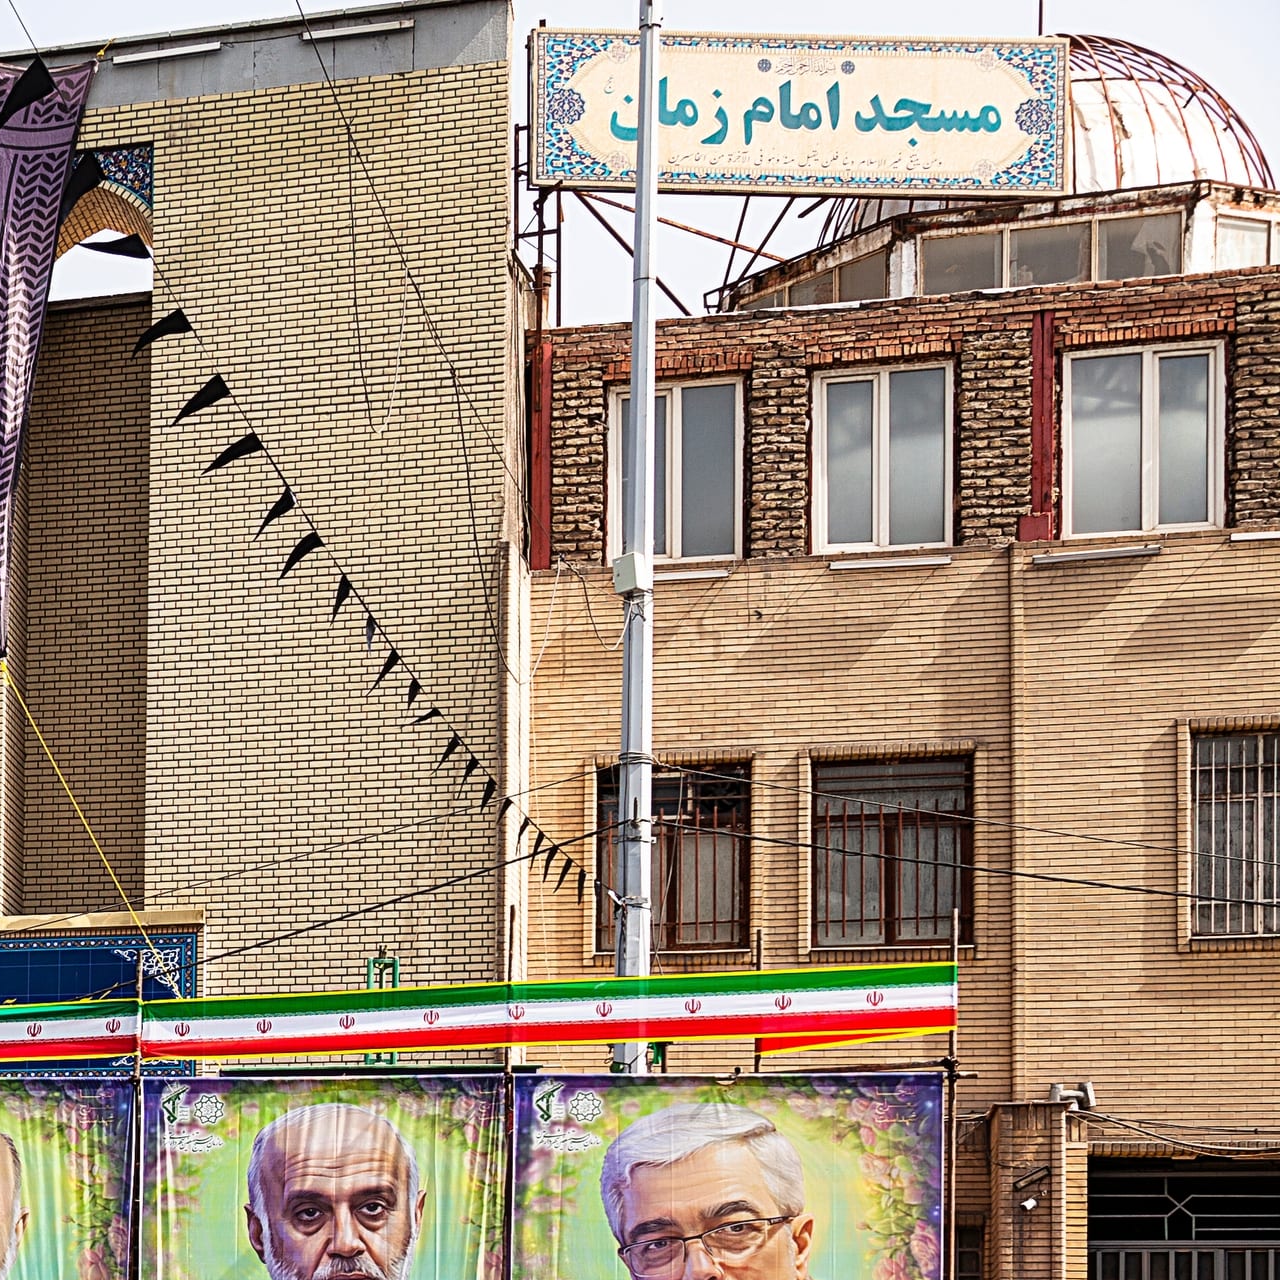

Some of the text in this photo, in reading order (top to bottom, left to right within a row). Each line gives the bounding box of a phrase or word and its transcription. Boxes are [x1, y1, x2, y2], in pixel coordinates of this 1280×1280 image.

[610, 75, 1003, 148] مسجد امام زمان
